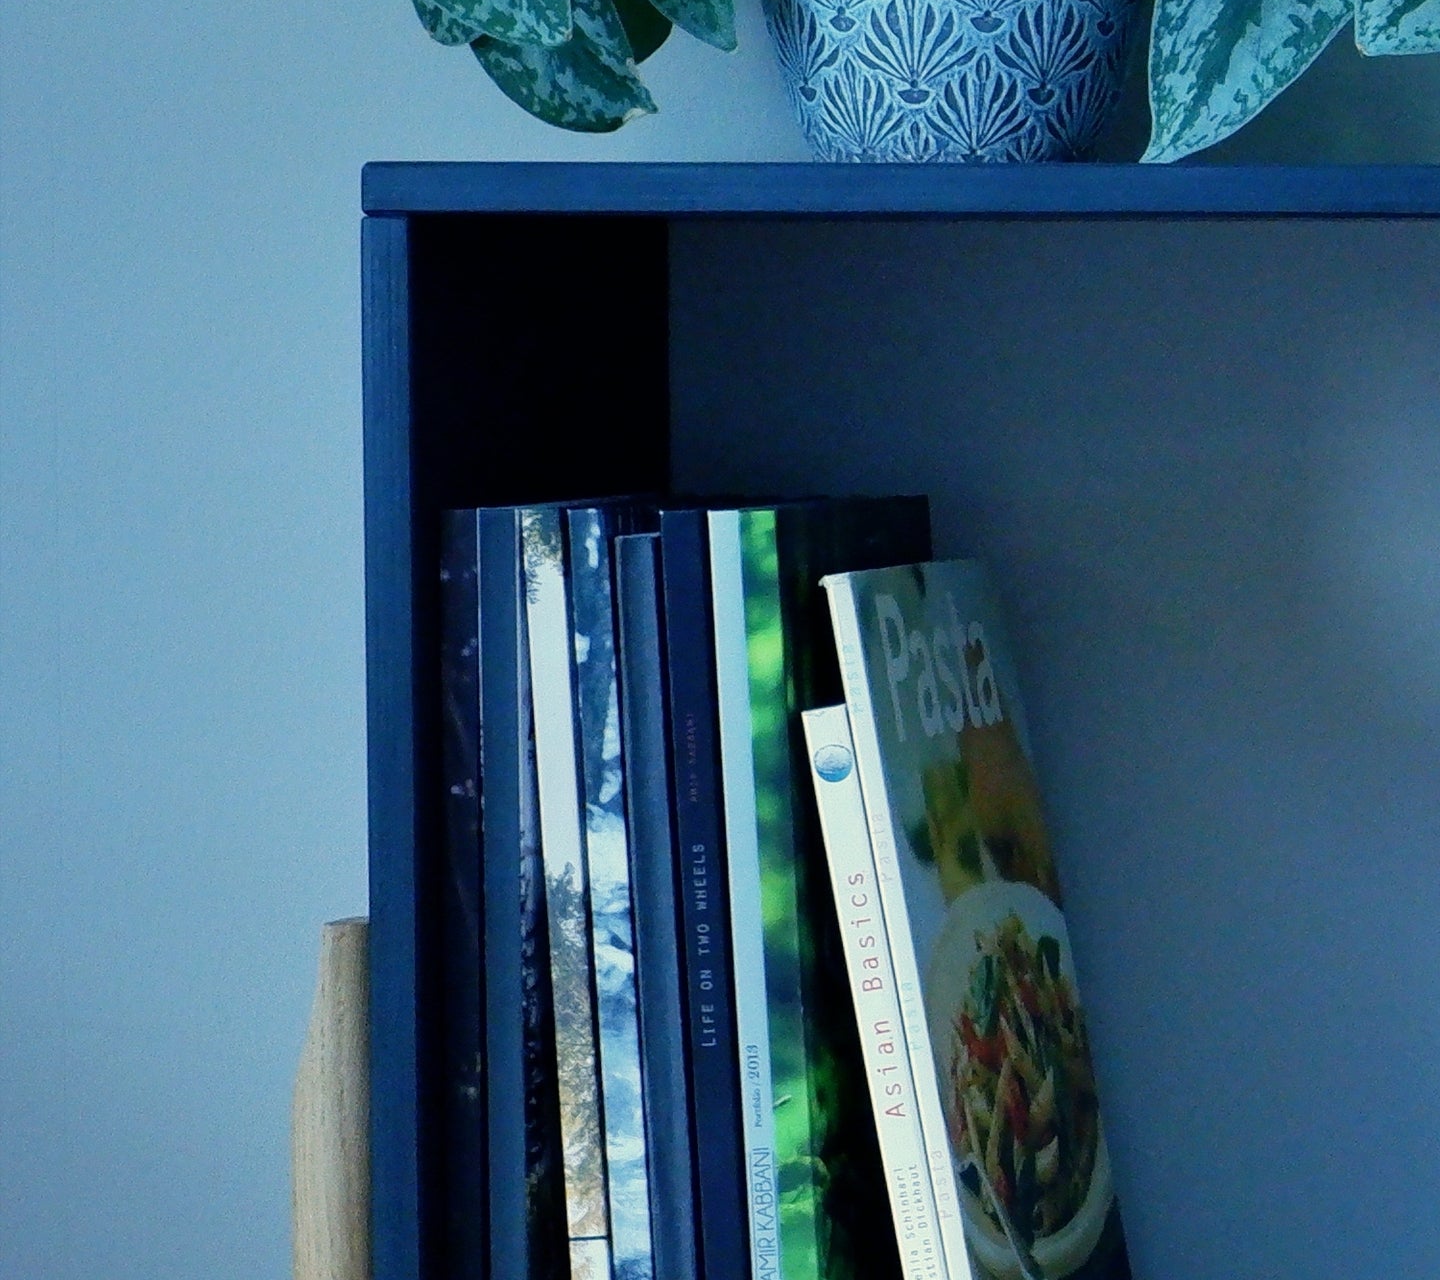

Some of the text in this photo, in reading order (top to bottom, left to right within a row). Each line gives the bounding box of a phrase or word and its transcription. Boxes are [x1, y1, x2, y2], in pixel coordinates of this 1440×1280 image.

[876, 592, 1003, 742] Pasta
[691, 843, 717, 1047] LIFE ON TWO WHEELS
[847, 872, 907, 1118] Asian Basics
[746, 1044, 760, 1080] 2013
[753, 1146, 776, 1232] KABBANI
[908, 1162, 929, 1229] Dickhaut
